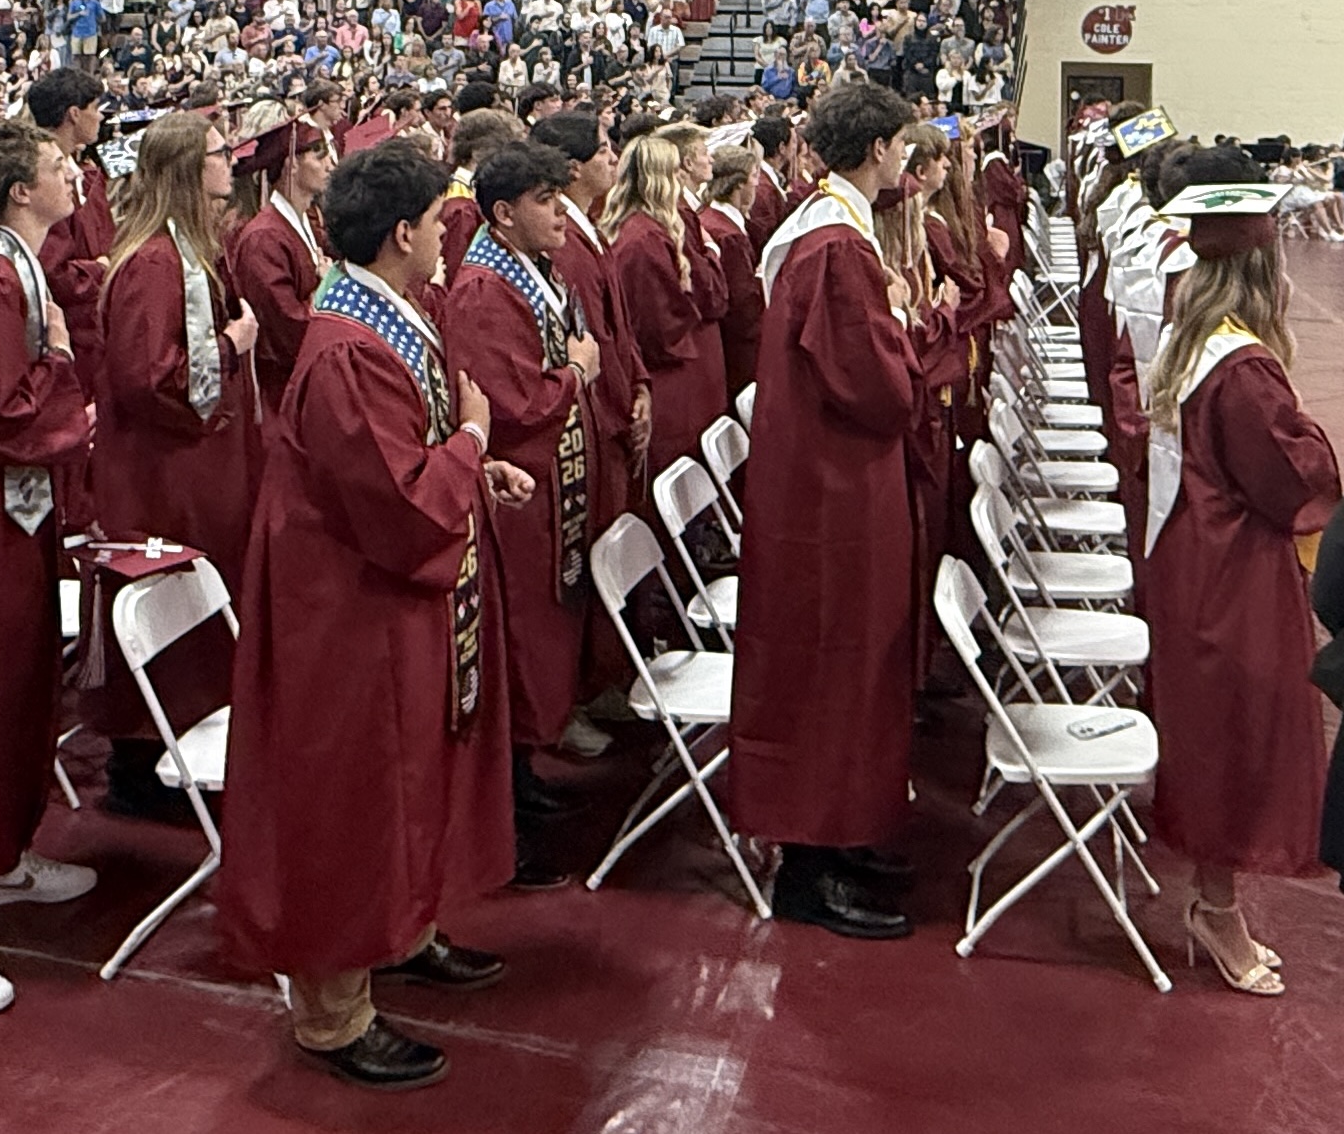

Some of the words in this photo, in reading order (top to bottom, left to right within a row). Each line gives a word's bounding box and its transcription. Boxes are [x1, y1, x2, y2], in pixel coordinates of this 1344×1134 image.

[1084, 33, 1129, 45] PAINTER
[1093, 23, 1121, 34] COLE
[558, 428, 584, 458] 20
[561, 455, 585, 486] 26
